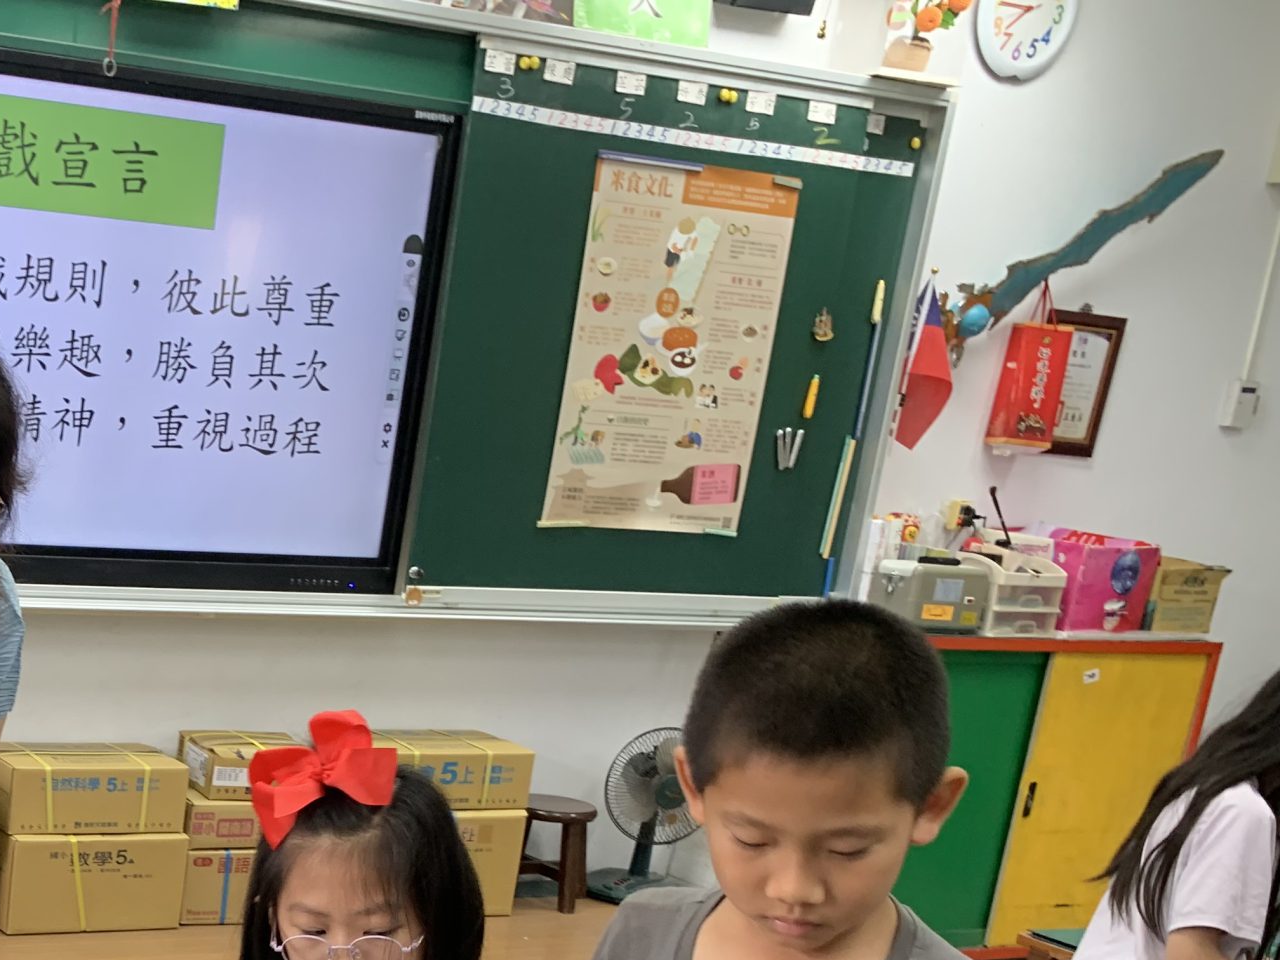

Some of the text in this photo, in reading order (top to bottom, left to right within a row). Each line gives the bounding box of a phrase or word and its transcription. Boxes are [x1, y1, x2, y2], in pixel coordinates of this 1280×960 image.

[1053, 5, 1065, 25] 3
[1000, 32, 1013, 51] 7
[1040, 26, 1053, 45] 4
[1011, 41, 1022, 60] 6
[1026, 38, 1039, 58] 5
[497, 77, 516, 98] 3
[679, 112, 699, 129] 2
[812, 126, 842, 146] 2
[610, 169, 673, 199] 米食文化
